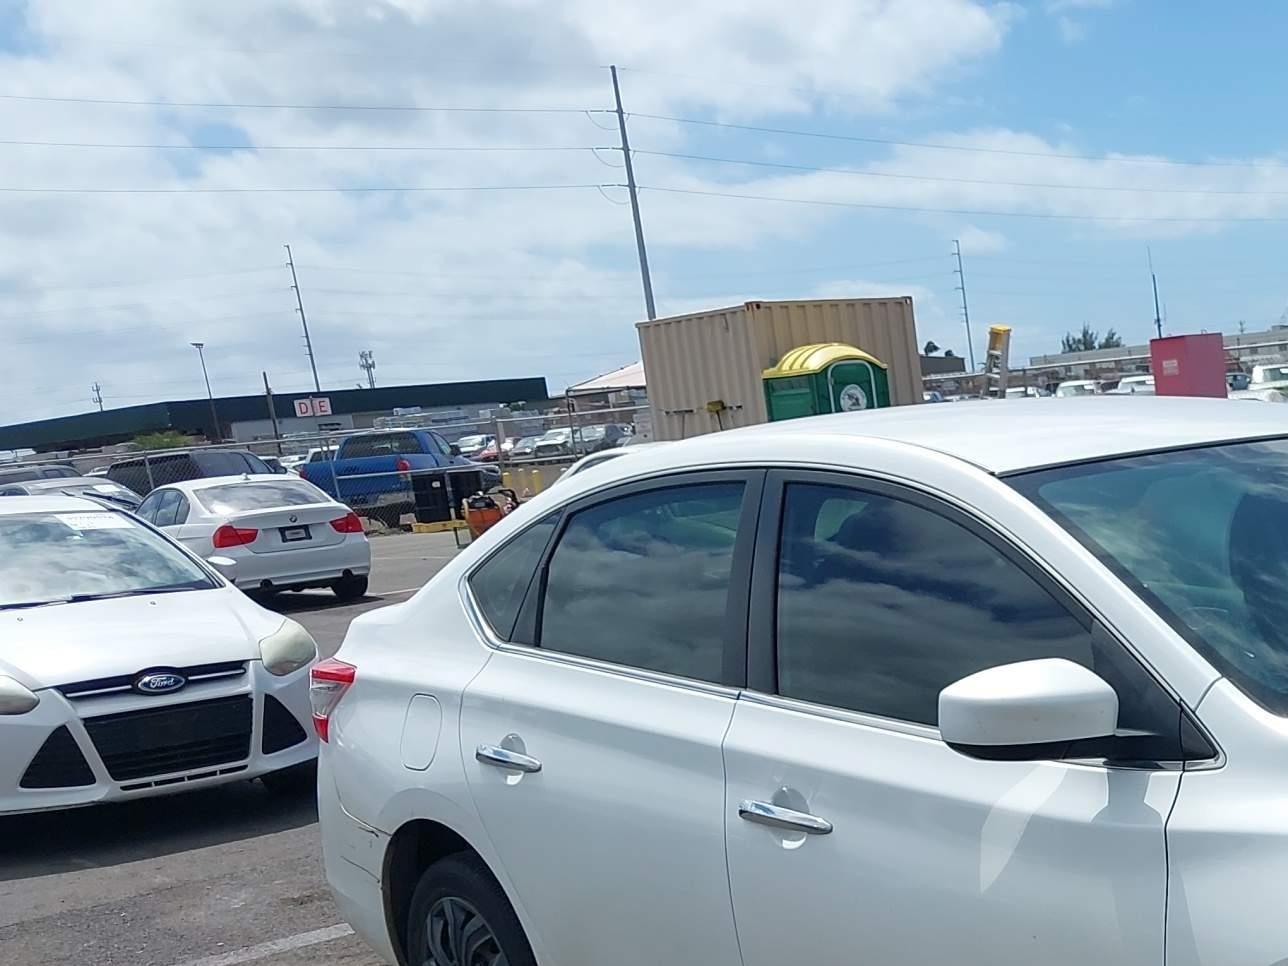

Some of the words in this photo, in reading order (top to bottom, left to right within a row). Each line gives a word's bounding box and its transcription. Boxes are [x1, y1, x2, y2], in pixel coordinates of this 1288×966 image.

[298, 402, 308, 415] D
[318, 400, 328, 412] E
[150, 677, 174, 688] Ford
